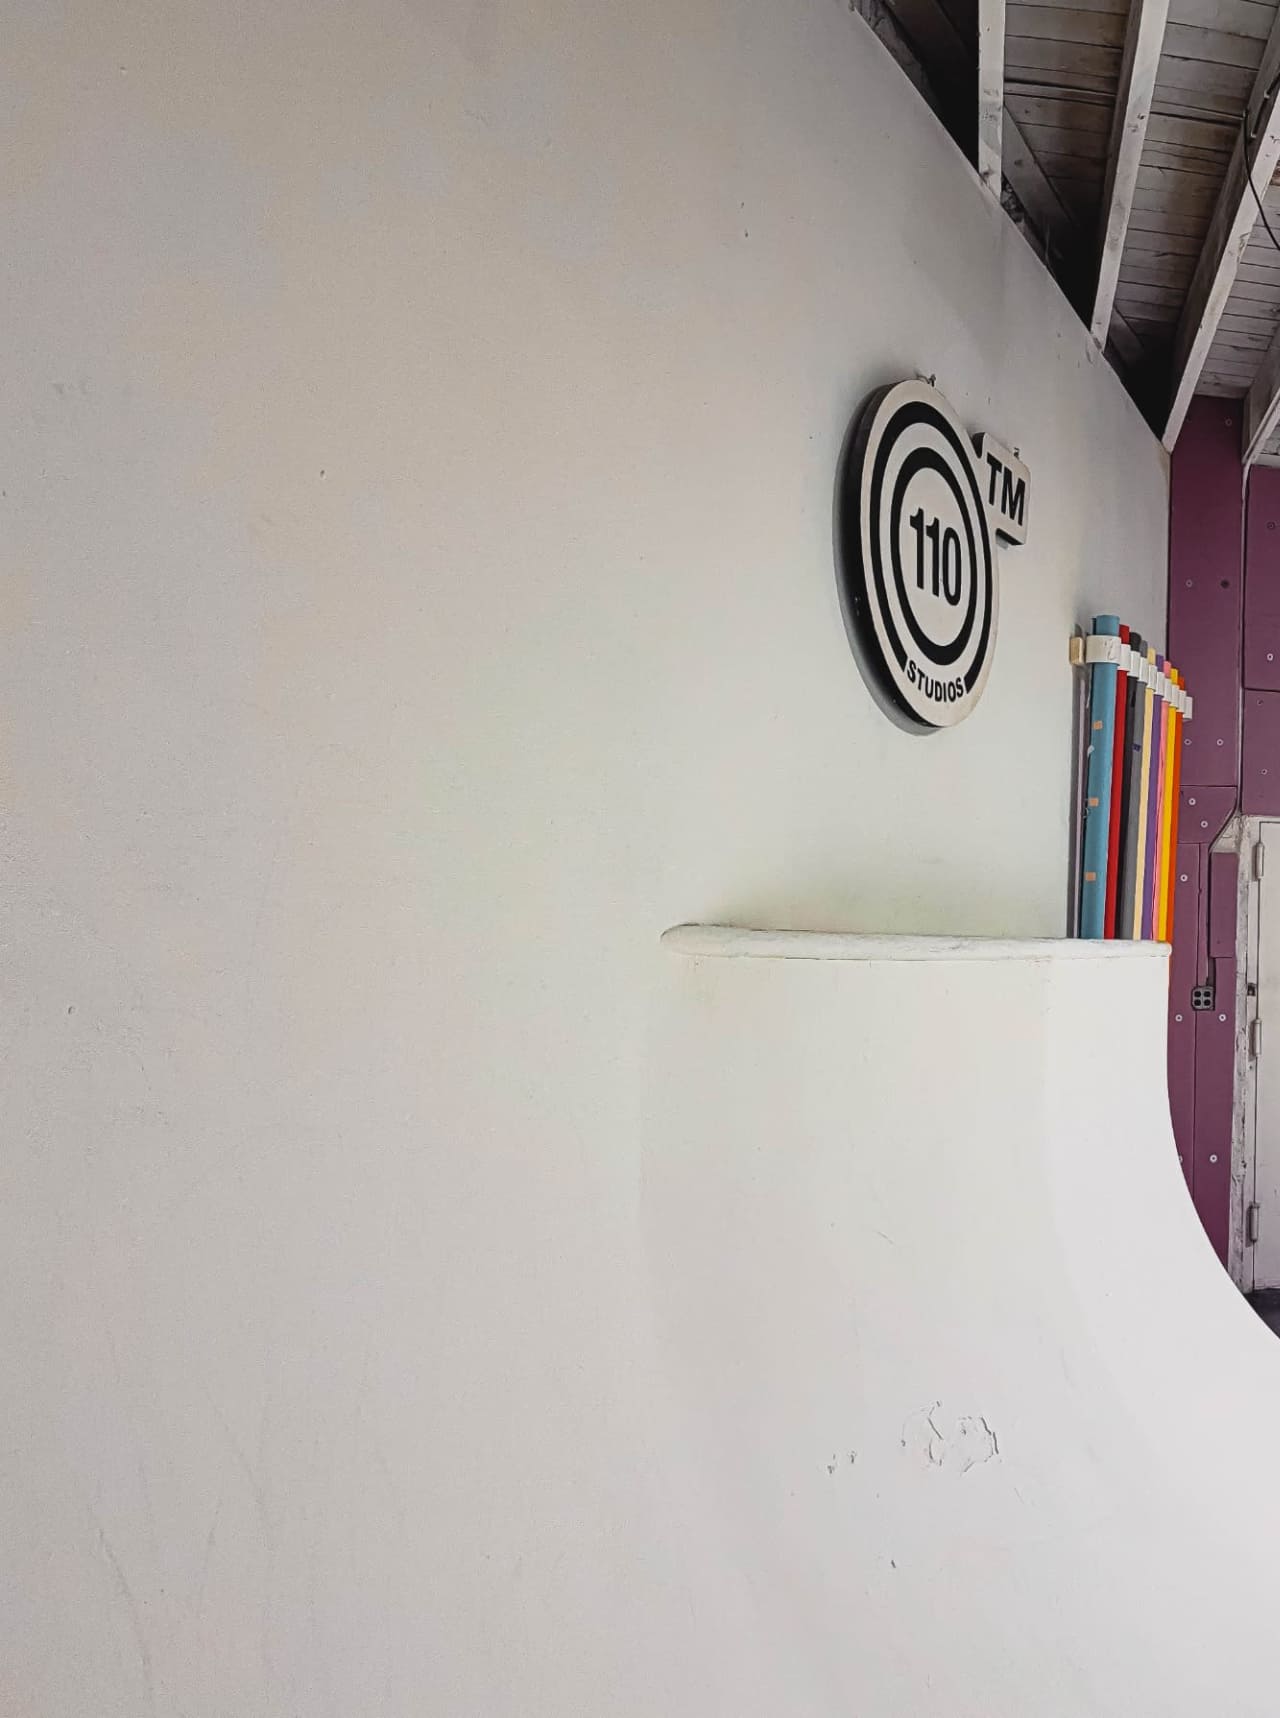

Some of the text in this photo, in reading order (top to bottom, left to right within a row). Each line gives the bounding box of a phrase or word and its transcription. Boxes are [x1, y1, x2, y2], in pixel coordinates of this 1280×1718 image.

[986, 453, 1026, 526] TM
[909, 507, 961, 606] 110
[906, 659, 964, 702] STUDIOS
